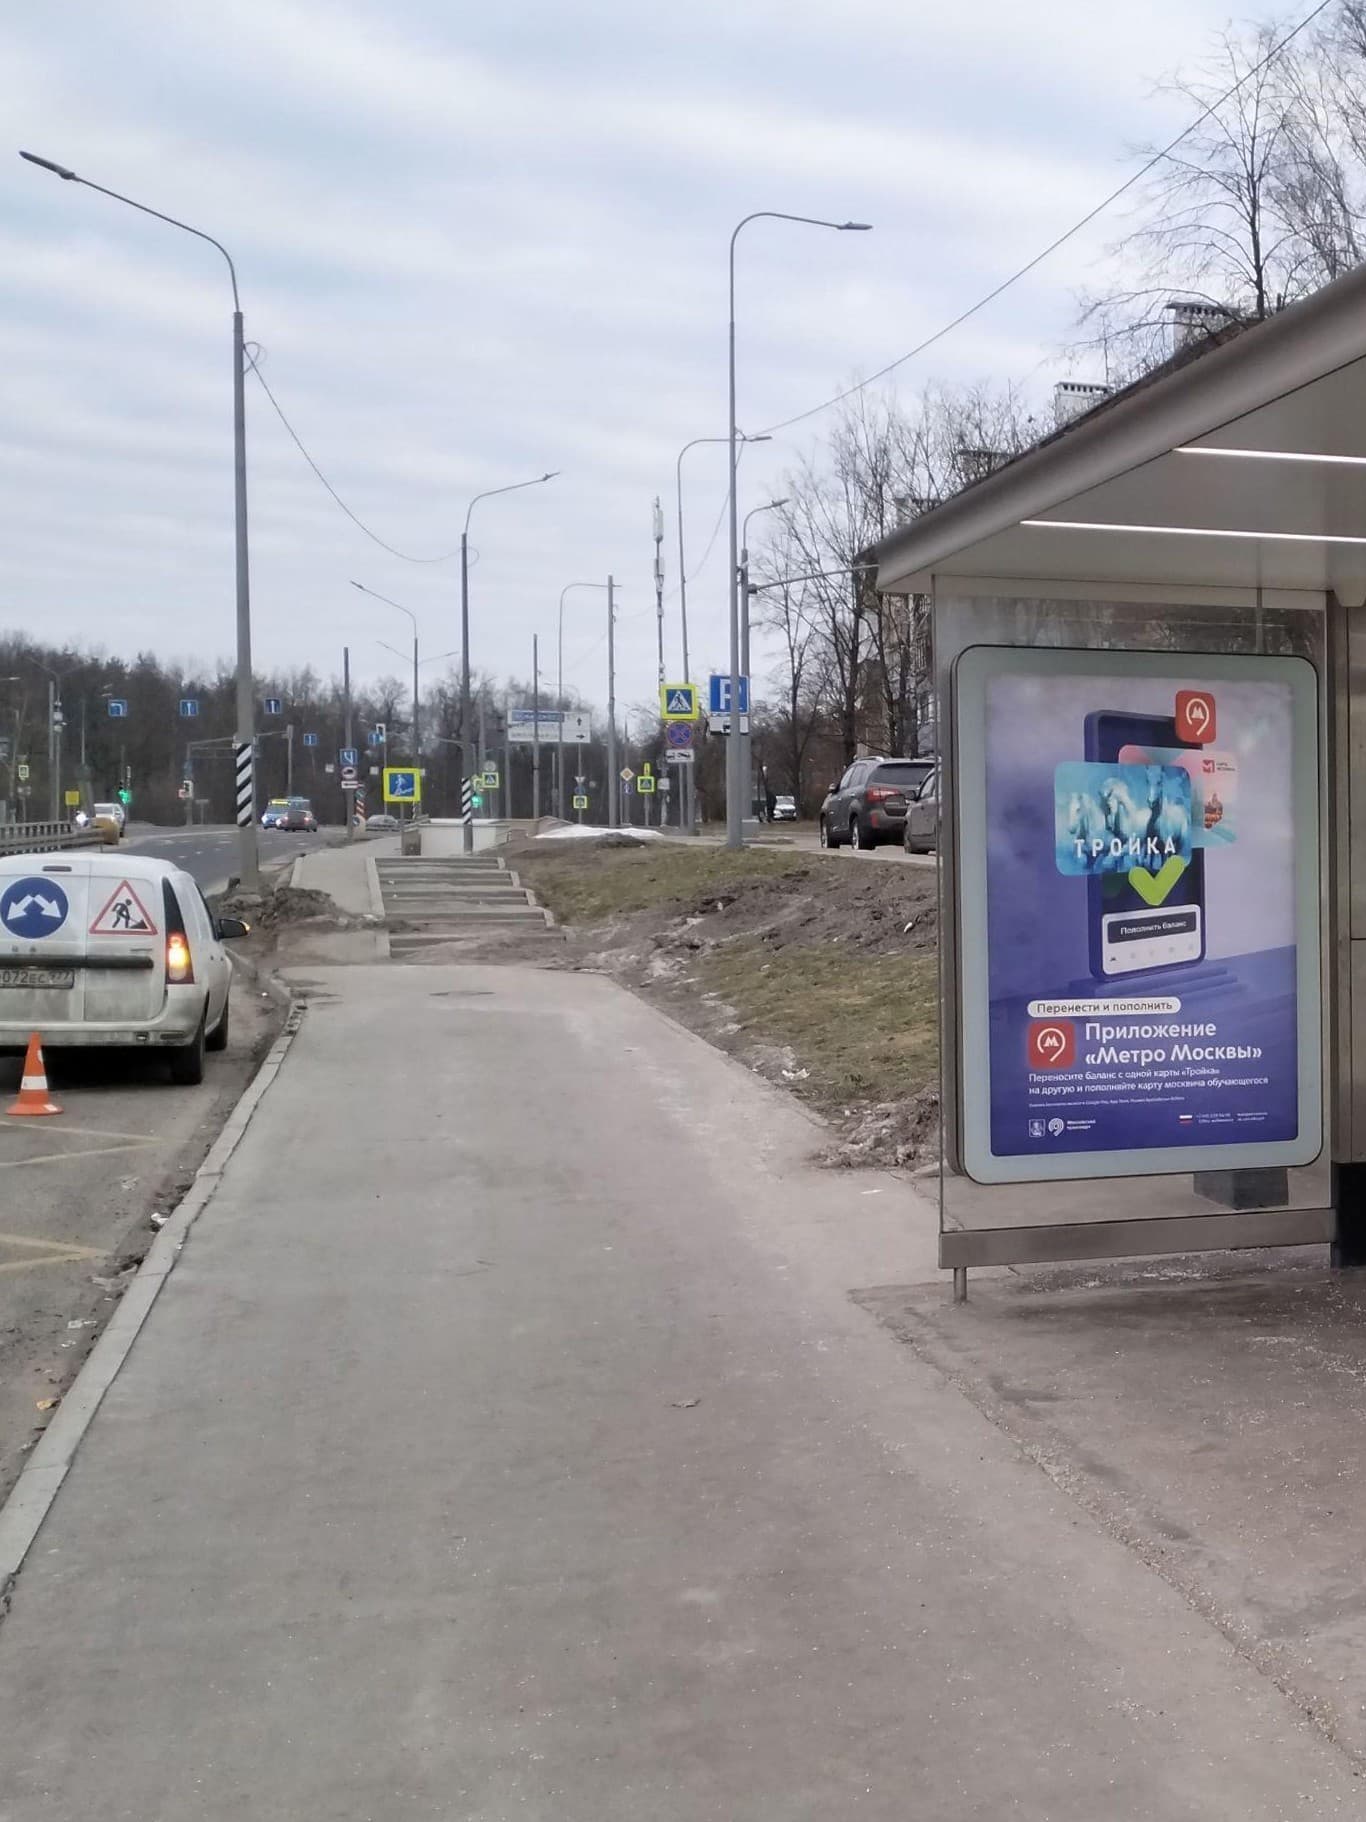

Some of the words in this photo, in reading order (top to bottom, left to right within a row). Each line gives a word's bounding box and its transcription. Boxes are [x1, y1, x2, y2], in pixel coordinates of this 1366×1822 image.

[1074, 832, 1176, 858] ТРОЙКА
[1120, 925, 1162, 935] Пополнить
[1162, 920, 1187, 930] баланс
[1037, 1003, 1100, 1014] Перенести
[1113, 1002, 1173, 1011] пополнить
[1085, 1022, 1217, 1044] Приложение
[1085, 1046, 1166, 1066] «Метро
[1171, 1044, 1262, 1061] Москвы»
[1029, 1072, 1083, 1083] Переносите
[1085, 1071, 1116, 1080] баланс
[1125, 1069, 1152, 1080] одной
[1154, 1070, 1180, 1078] карты
[1041, 1085, 1075, 1095] другую
[1085, 1081, 1136, 1092] пополняйте
[1138, 1081, 1162, 1090] карту
[1207, 1077, 1269, 1088] обучающегося
